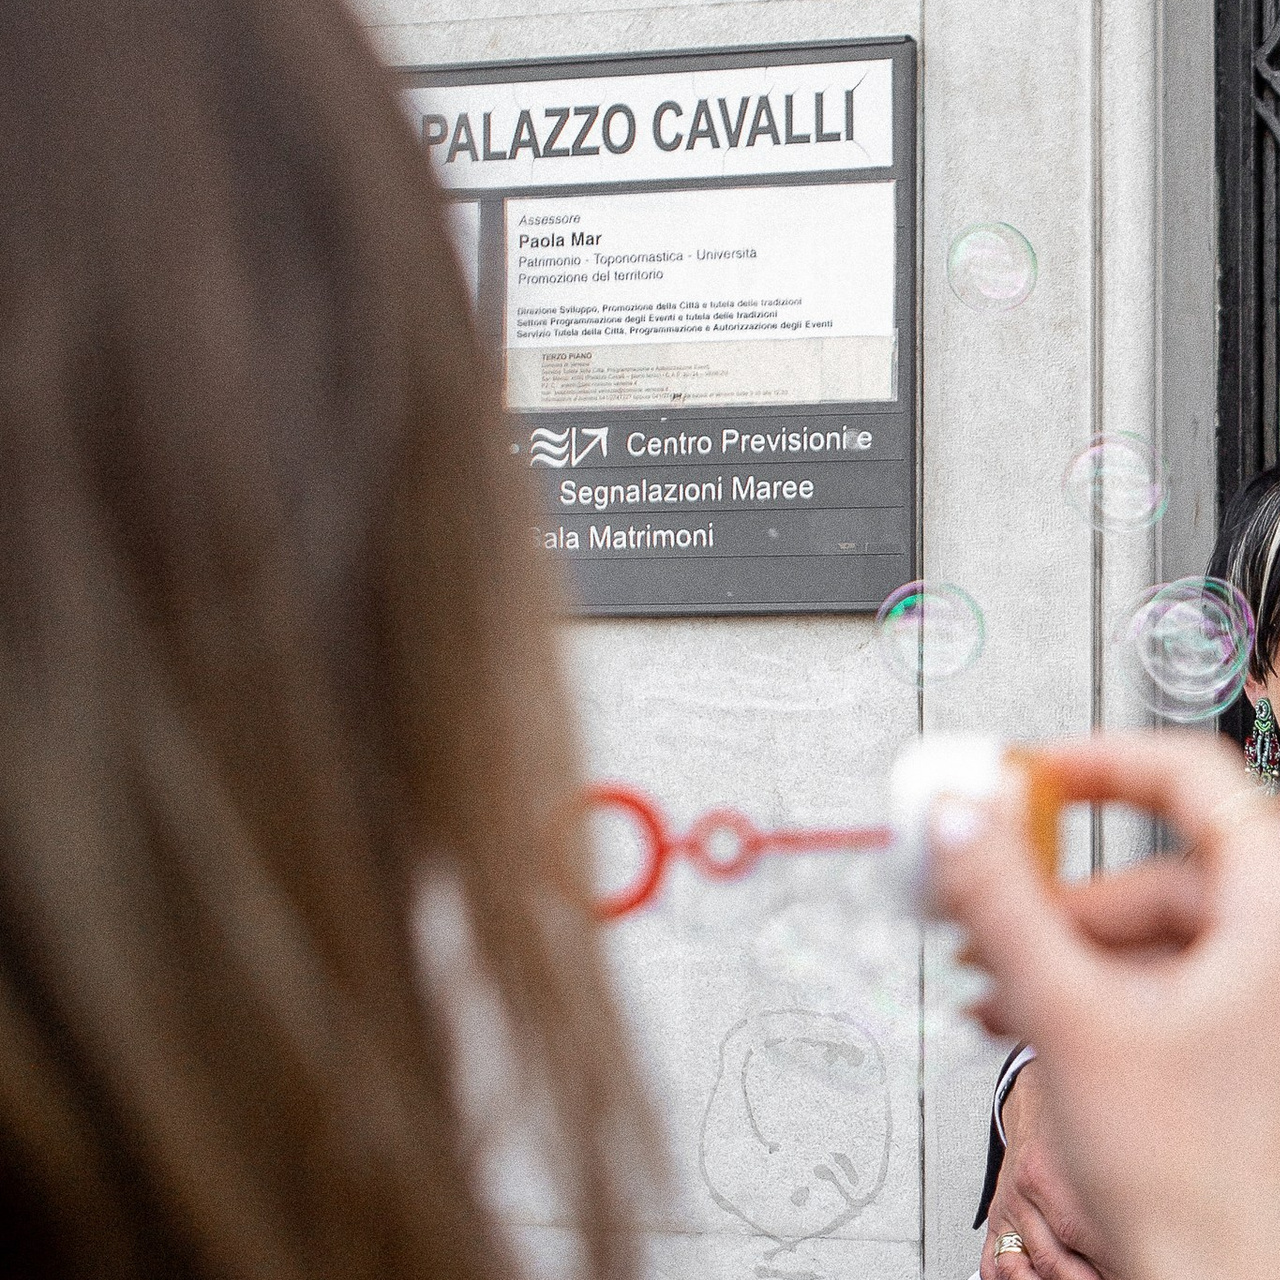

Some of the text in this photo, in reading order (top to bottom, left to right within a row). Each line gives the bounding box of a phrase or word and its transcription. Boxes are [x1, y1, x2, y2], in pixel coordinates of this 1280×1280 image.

[422, 89, 853, 163] PALAZZO CAVALLI
[519, 214, 581, 226] Assessore
[519, 231, 602, 249] Paola Mar
[518, 255, 581, 268] Patrimonio
[593, 251, 683, 267] Toponomastica
[696, 248, 757, 261] Università
[518, 269, 664, 285] Promozione del territorio
[559, 306, 599, 315] Sviluppo,
[602, 303, 653, 312] Promozione
[656, 302, 676, 310] della
[761, 298, 802, 306] tradizioni
[517, 319, 547, 327] Settore
[550, 317, 622, 327] Programmazione
[625, 315, 645, 325] degli
[649, 314, 675, 322] Eventi
[737, 310, 778, 319] tradizioni
[516, 330, 550, 338] Servizio
[554, 329, 579, 337] Tutela
[581, 328, 602, 336] della
[629, 325, 702, 335] Programmazione
[713, 322, 778, 332] Autorizzazione
[780, 321, 802, 332] degli
[805, 320, 833, 329] Eventi
[626, 424, 873, 457] Centro Previsioni e
[560, 475, 814, 510] Segnalazioni Maree
[590, 522, 713, 551] Matrimoni
